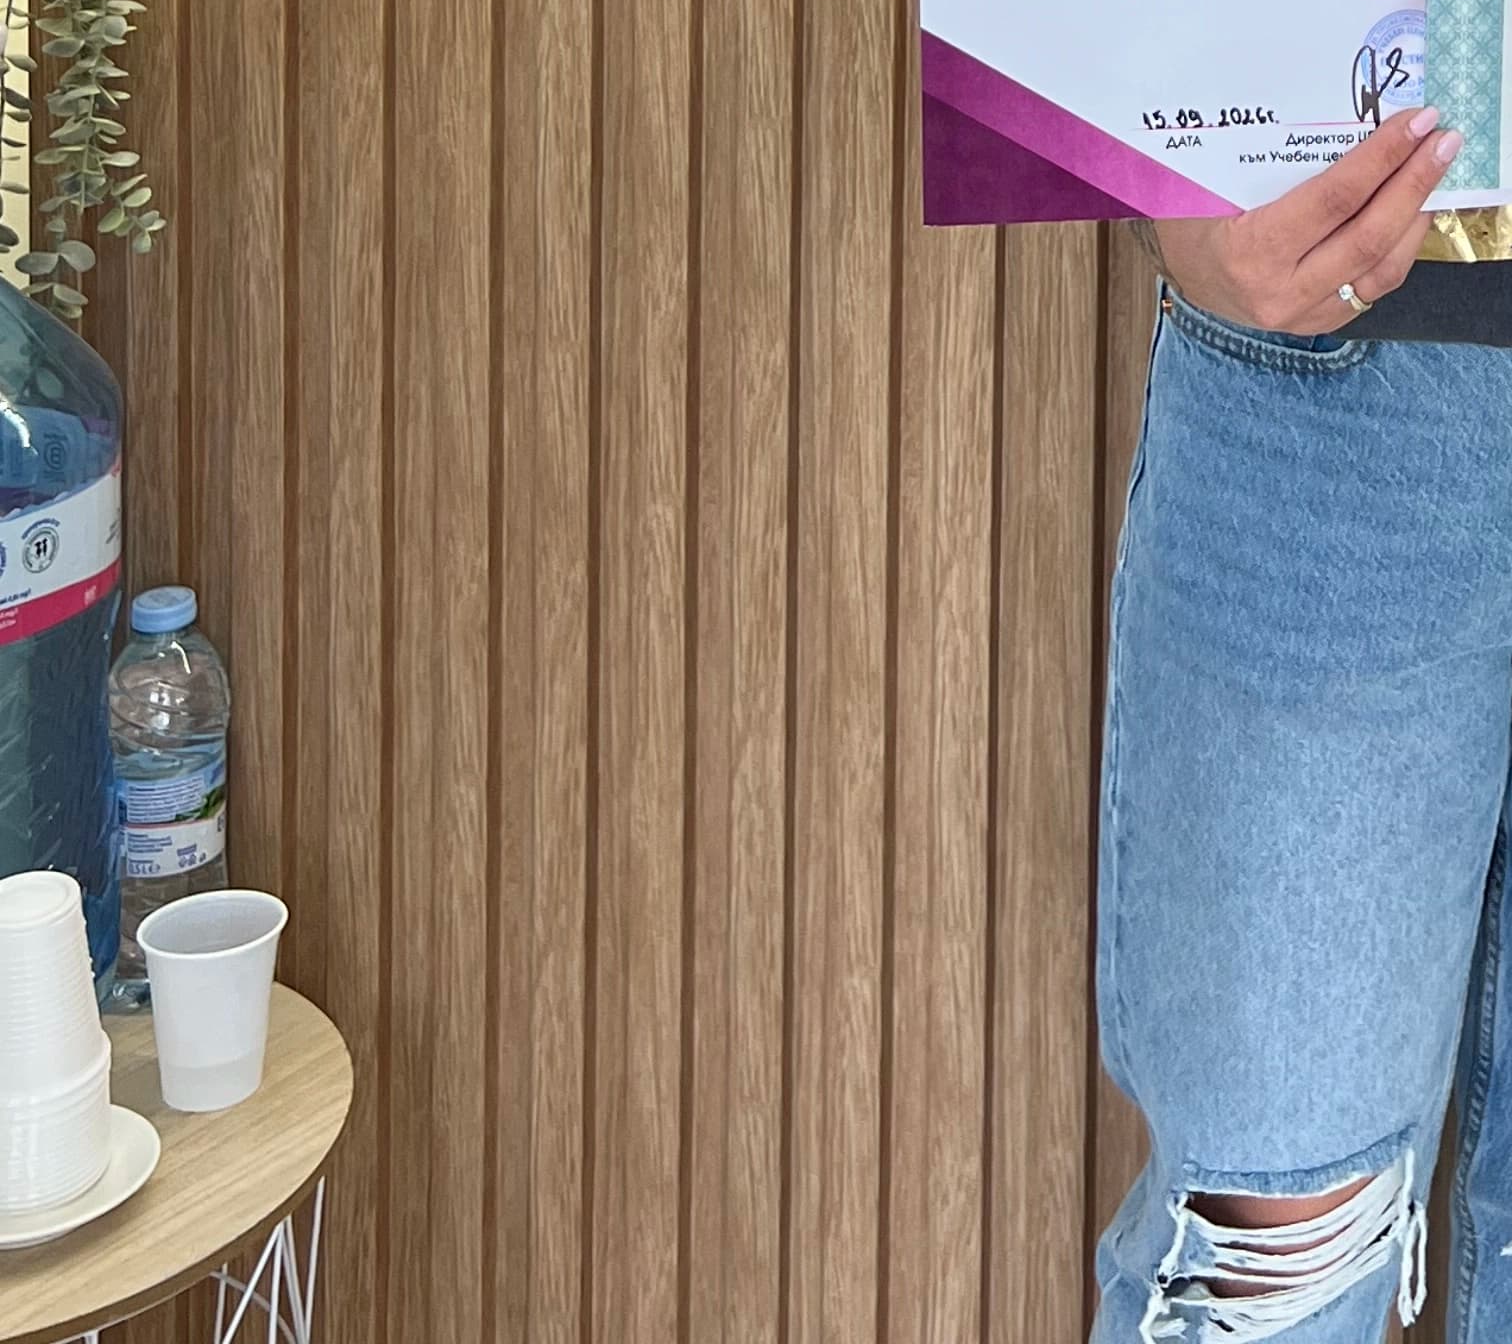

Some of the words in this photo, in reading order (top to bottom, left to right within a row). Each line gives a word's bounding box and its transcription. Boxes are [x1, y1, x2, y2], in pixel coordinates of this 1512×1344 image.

[1166, 135, 1202, 150] ДАТА
[1285, 132, 1355, 148] Директор
[1239, 153, 1266, 163] към
[1268, 150, 1319, 164] Учебен
